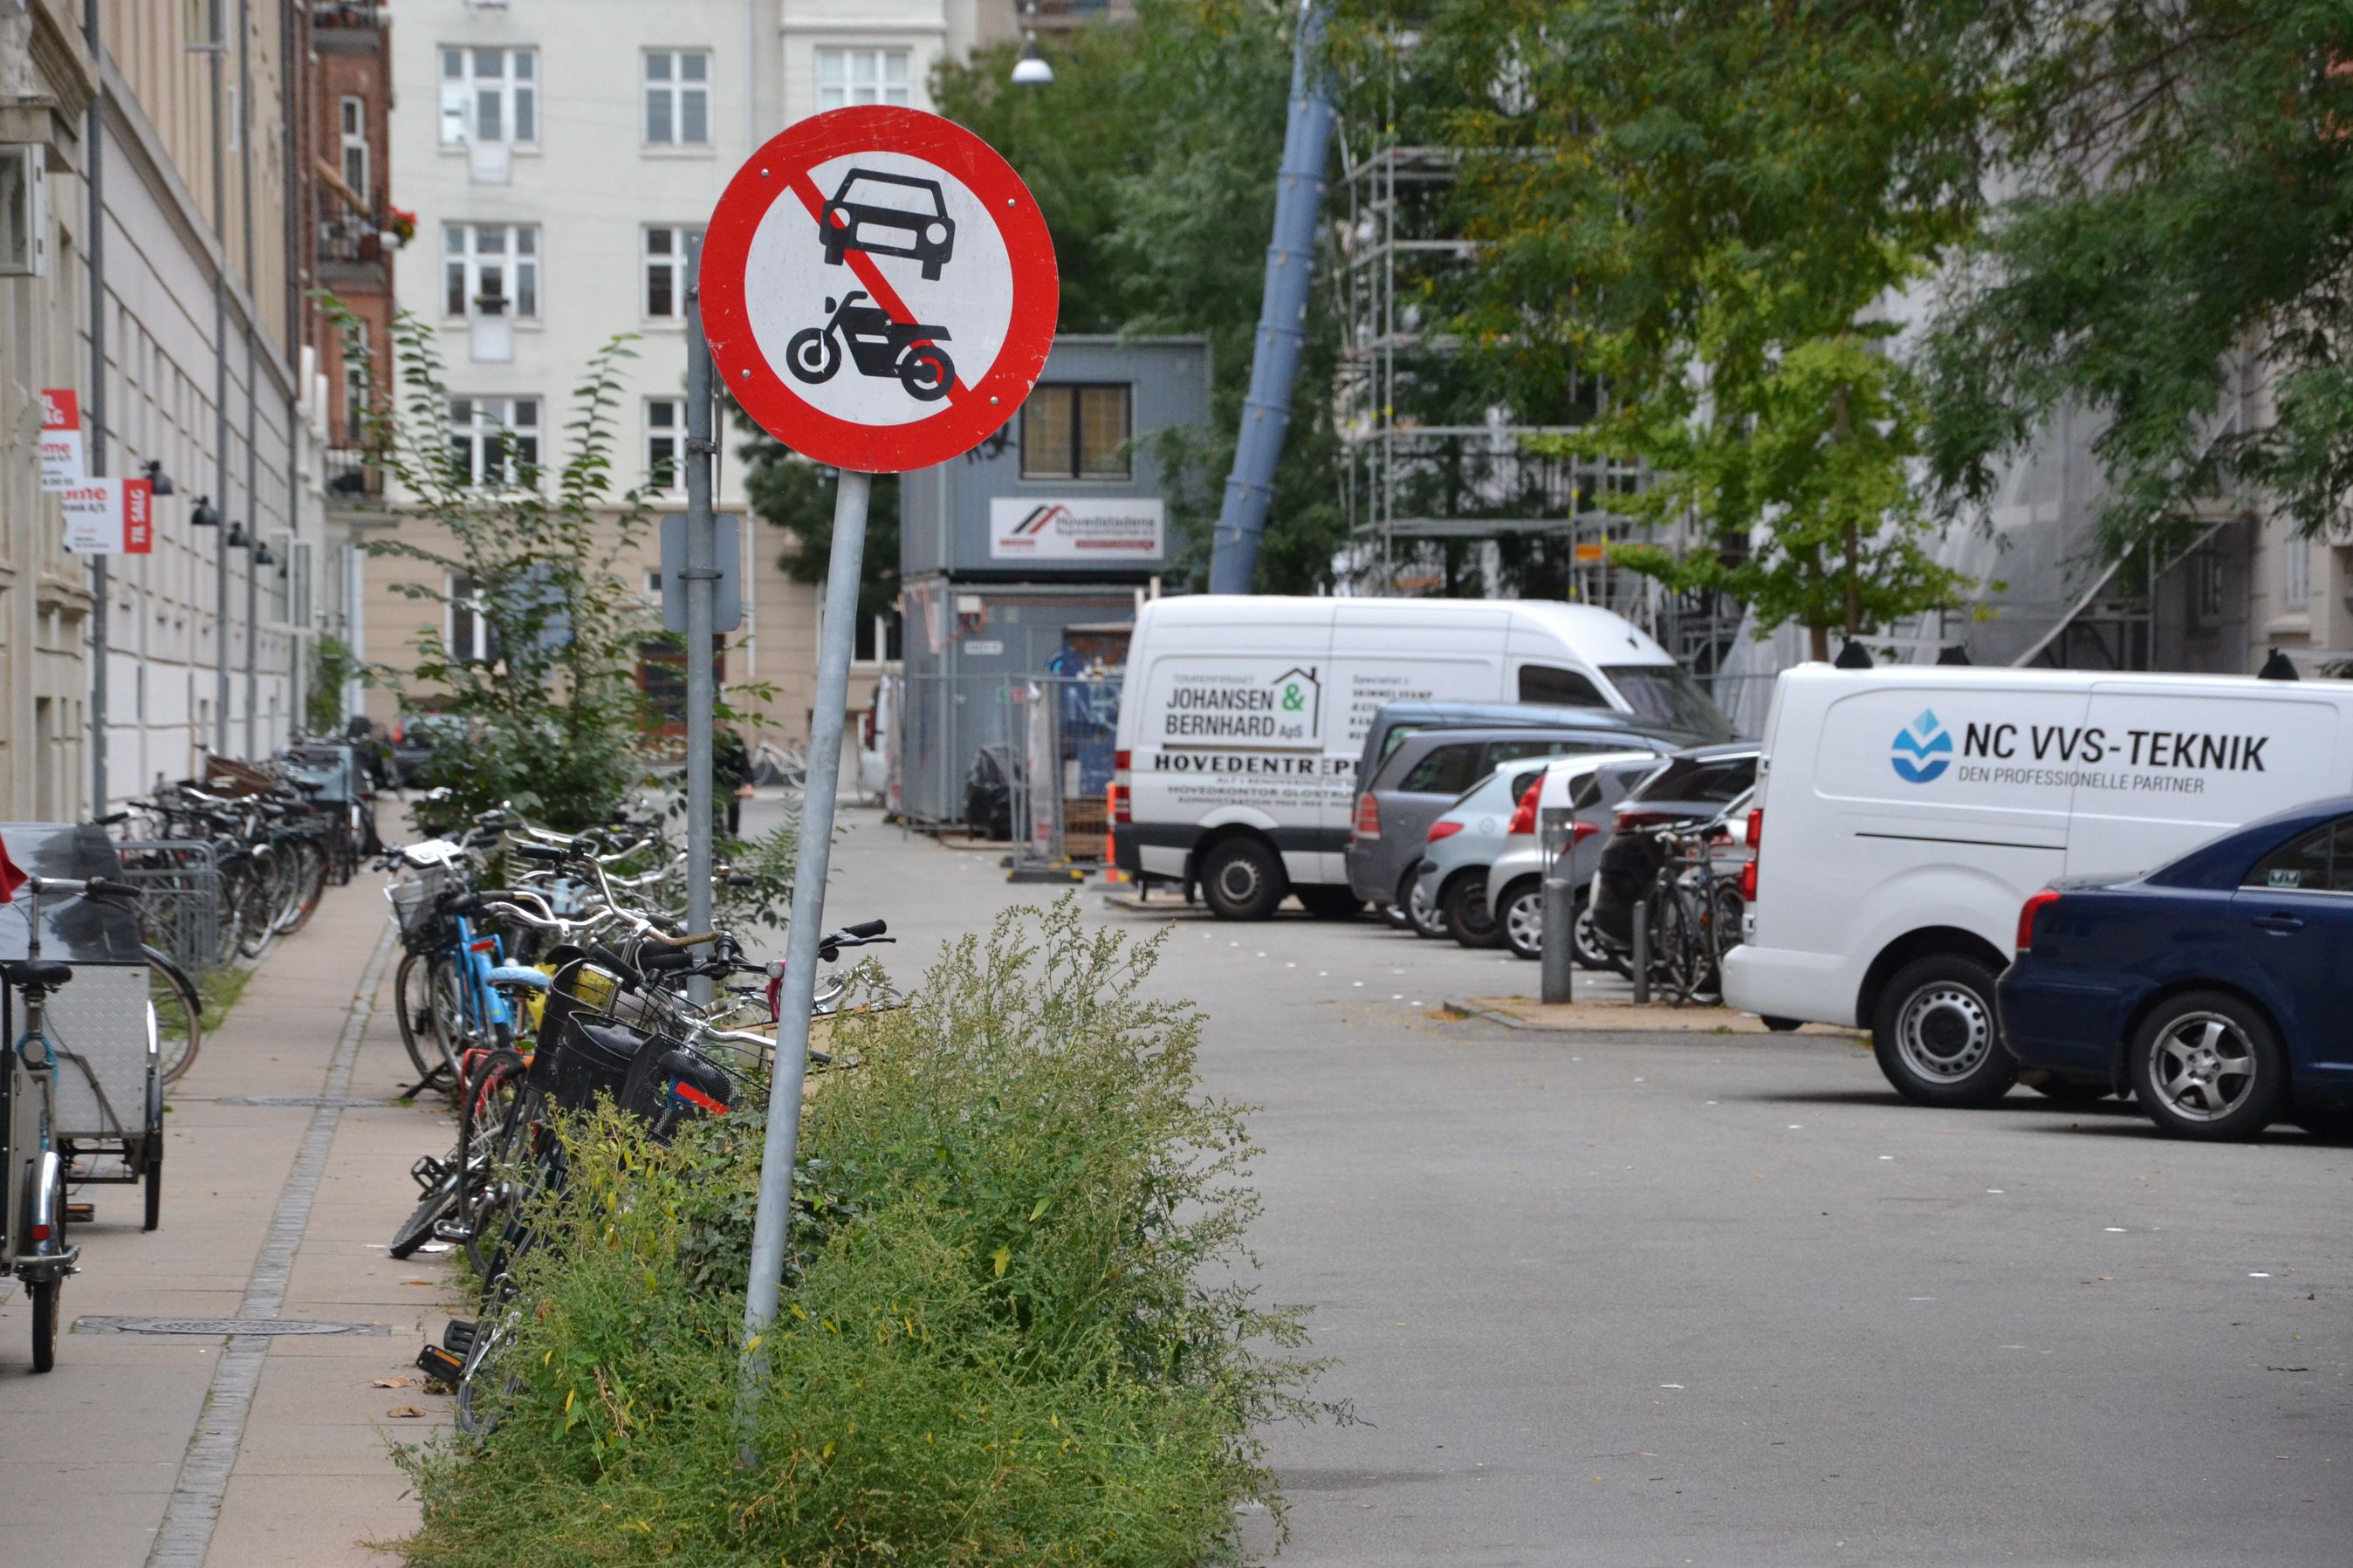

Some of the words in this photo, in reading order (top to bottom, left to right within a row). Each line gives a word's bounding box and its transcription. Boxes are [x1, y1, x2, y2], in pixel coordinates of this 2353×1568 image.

[130, 488, 146, 524] SALG
[132, 525, 147, 544] TIL
[1166, 688, 1274, 711] JOHANSEN
[1281, 683, 1305, 711] &
[1166, 714, 1276, 738] BERNHARD
[1964, 722, 2018, 759] NC
[2031, 726, 2269, 772] VVS-TEKNIK
[1959, 765, 1991, 783] DEN
[1993, 767, 2130, 791] PROFESSIONELLE
[2133, 775, 2205, 794] PARTNER
[1281, 789, 1355, 799] GLOSTRU
